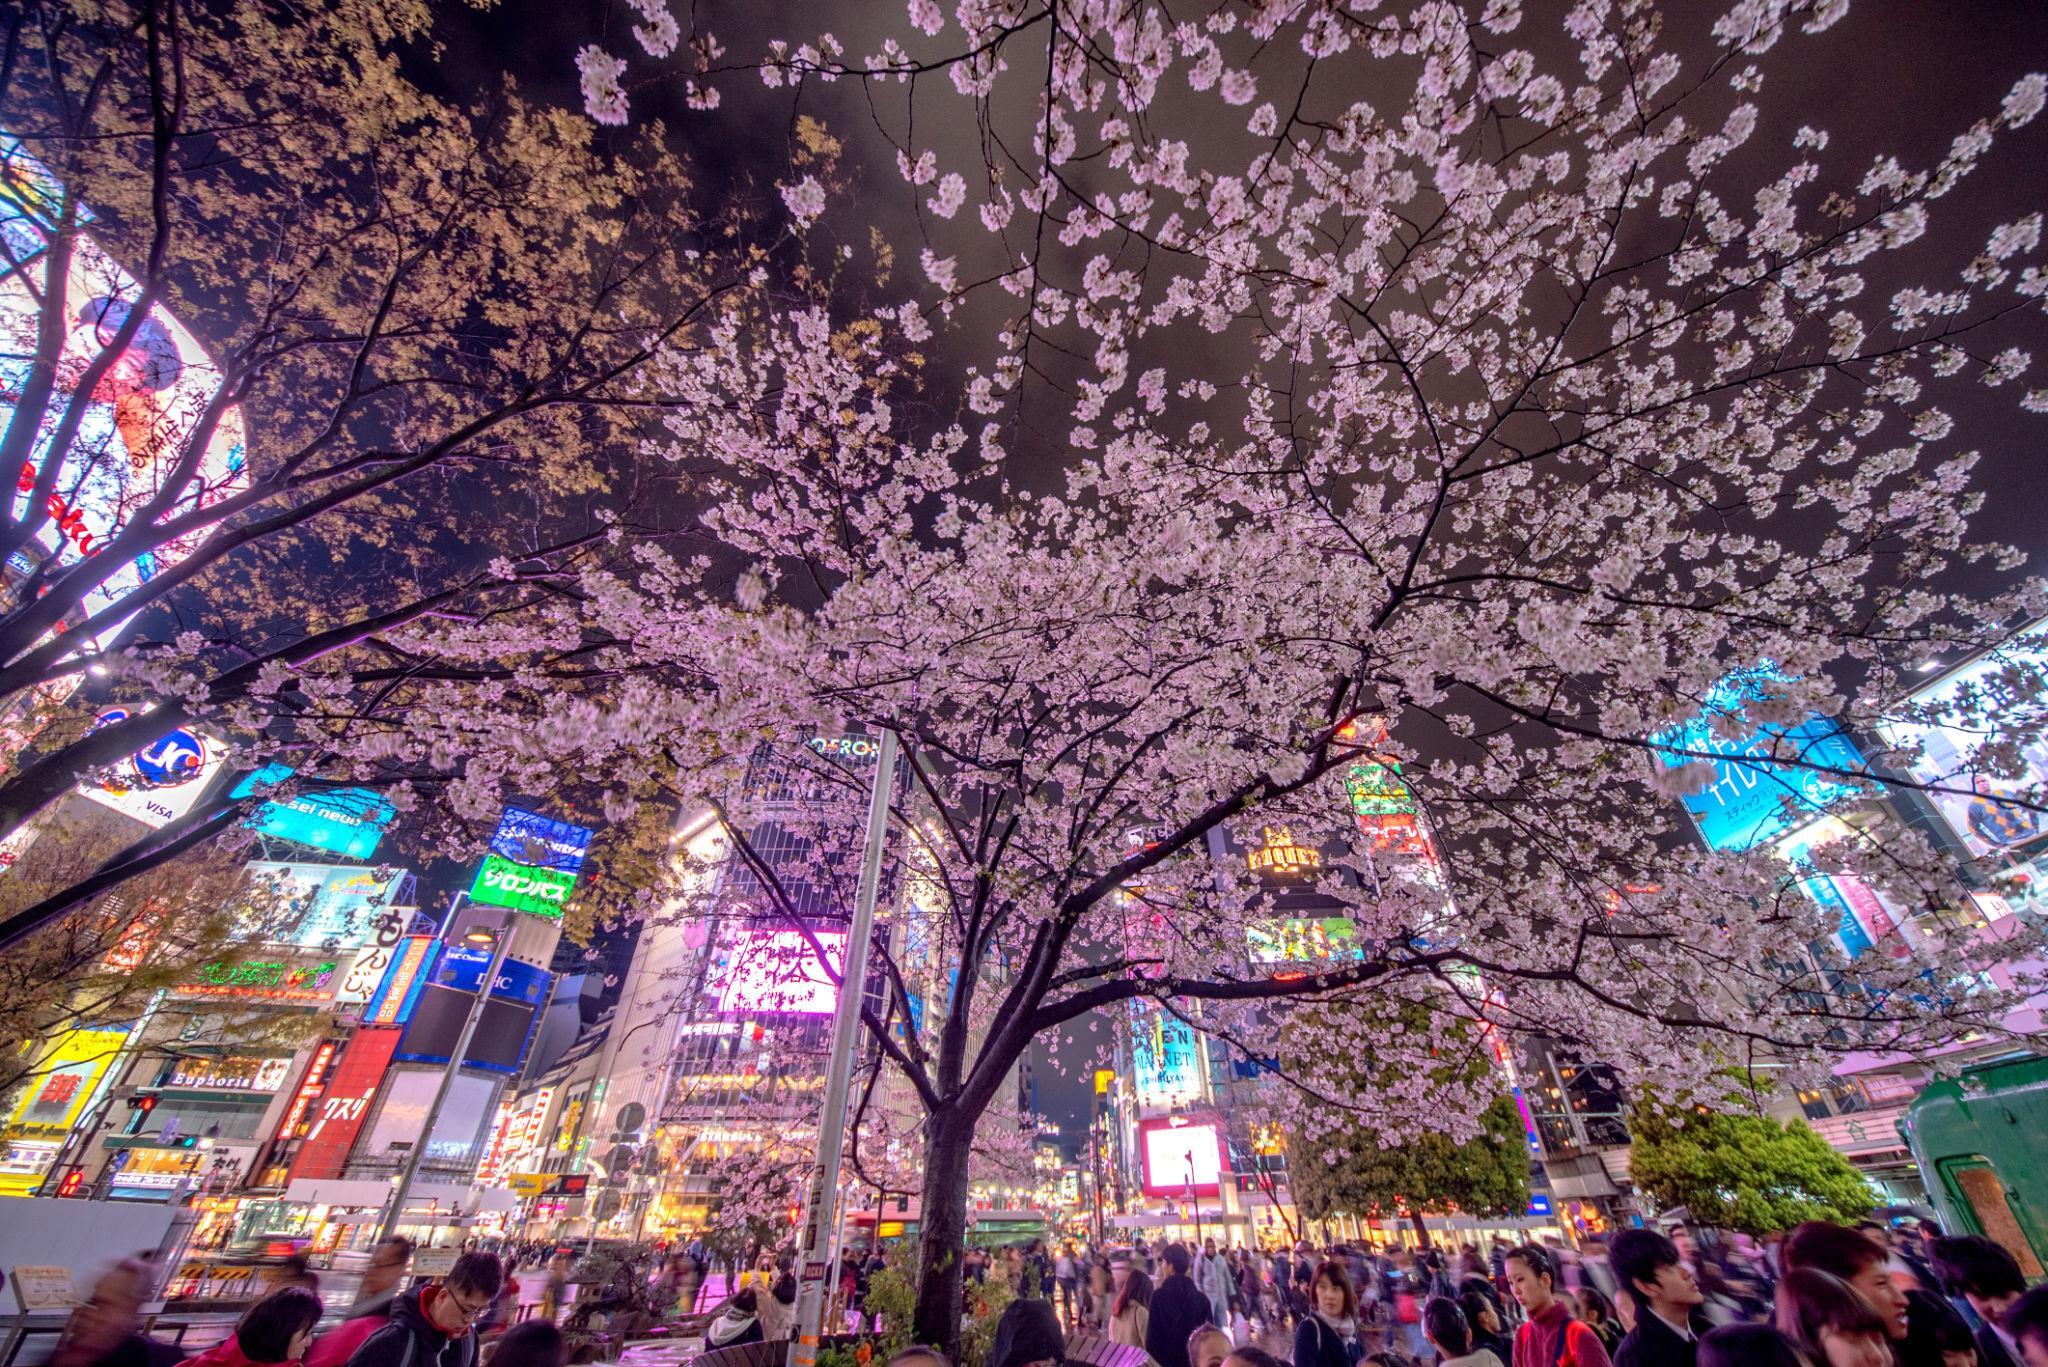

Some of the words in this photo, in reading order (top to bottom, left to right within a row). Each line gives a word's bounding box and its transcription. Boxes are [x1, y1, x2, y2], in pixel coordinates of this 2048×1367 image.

[811, 737, 880, 757] QFRON
[145, 800, 174, 820] VISA
[317, 807, 361, 827] neon
[483, 868, 566, 902] サロンパス
[345, 909, 403, 1000] もんじゃ
[462, 954, 488, 963] Channel
[1136, 1052, 1190, 1069] MANET
[171, 1073, 250, 1088] Euphoria
[324, 1098, 369, 1120] クスリ
